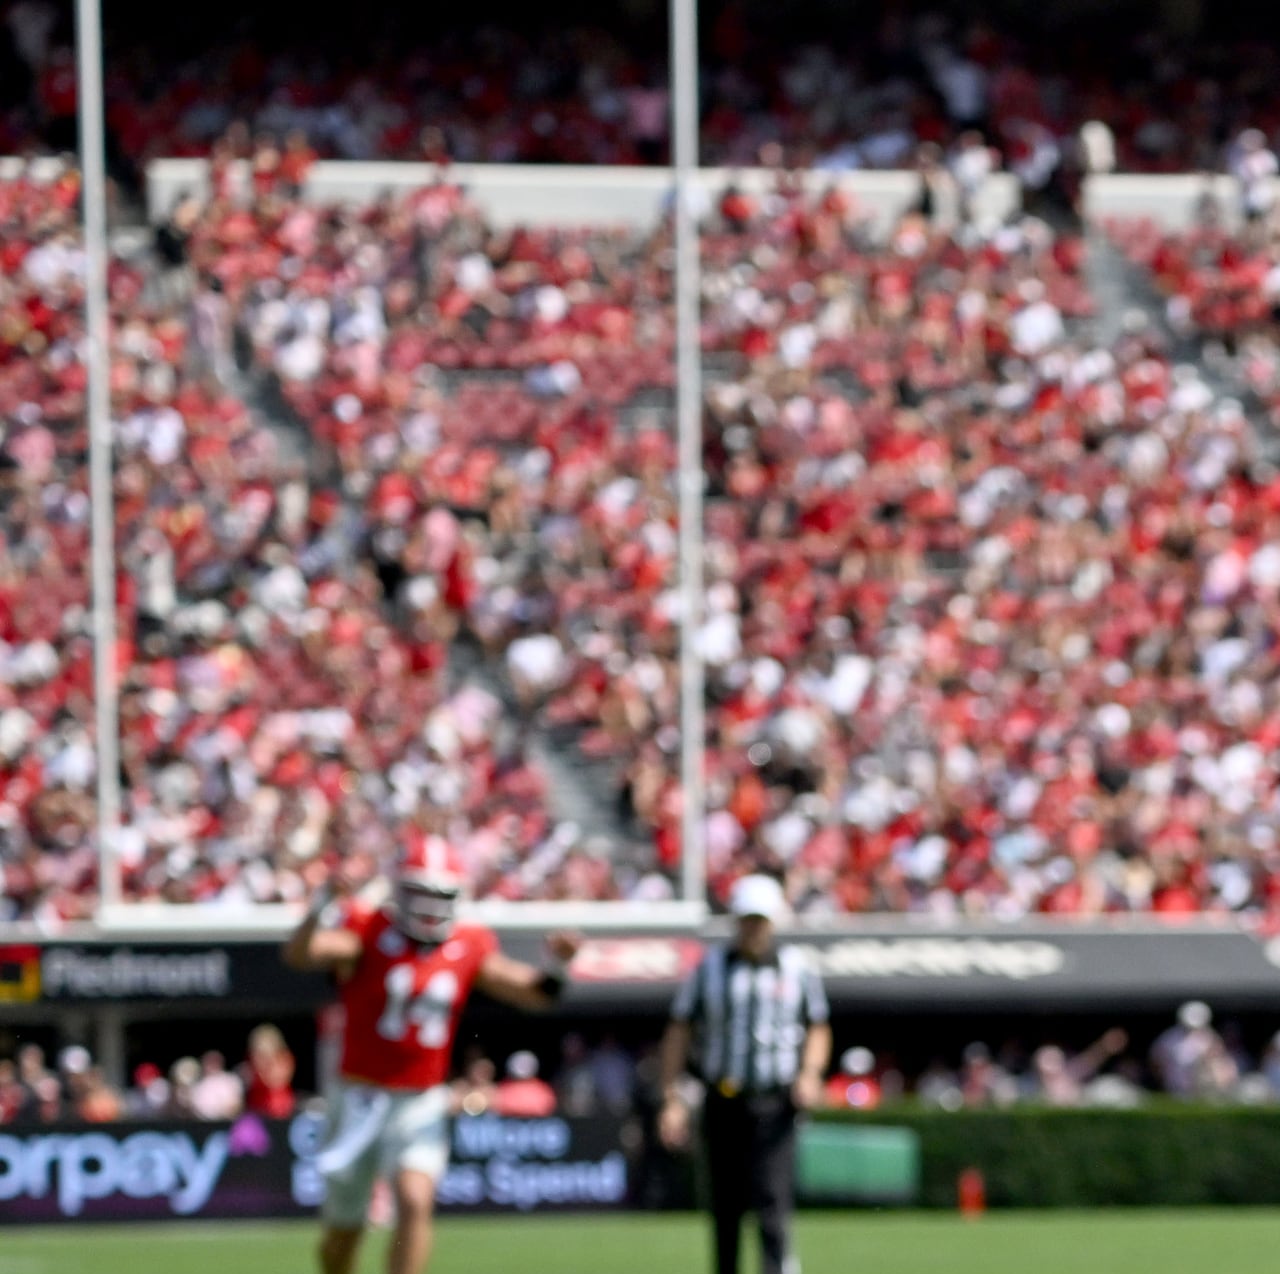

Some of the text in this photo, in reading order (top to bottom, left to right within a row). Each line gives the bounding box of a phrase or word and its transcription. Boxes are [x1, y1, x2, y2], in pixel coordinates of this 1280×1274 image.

[43, 947, 229, 998] Piedmont
[376, 962, 459, 1048] 14
[455, 1114, 571, 1160] More
[486, 1151, 628, 1210] Spend
